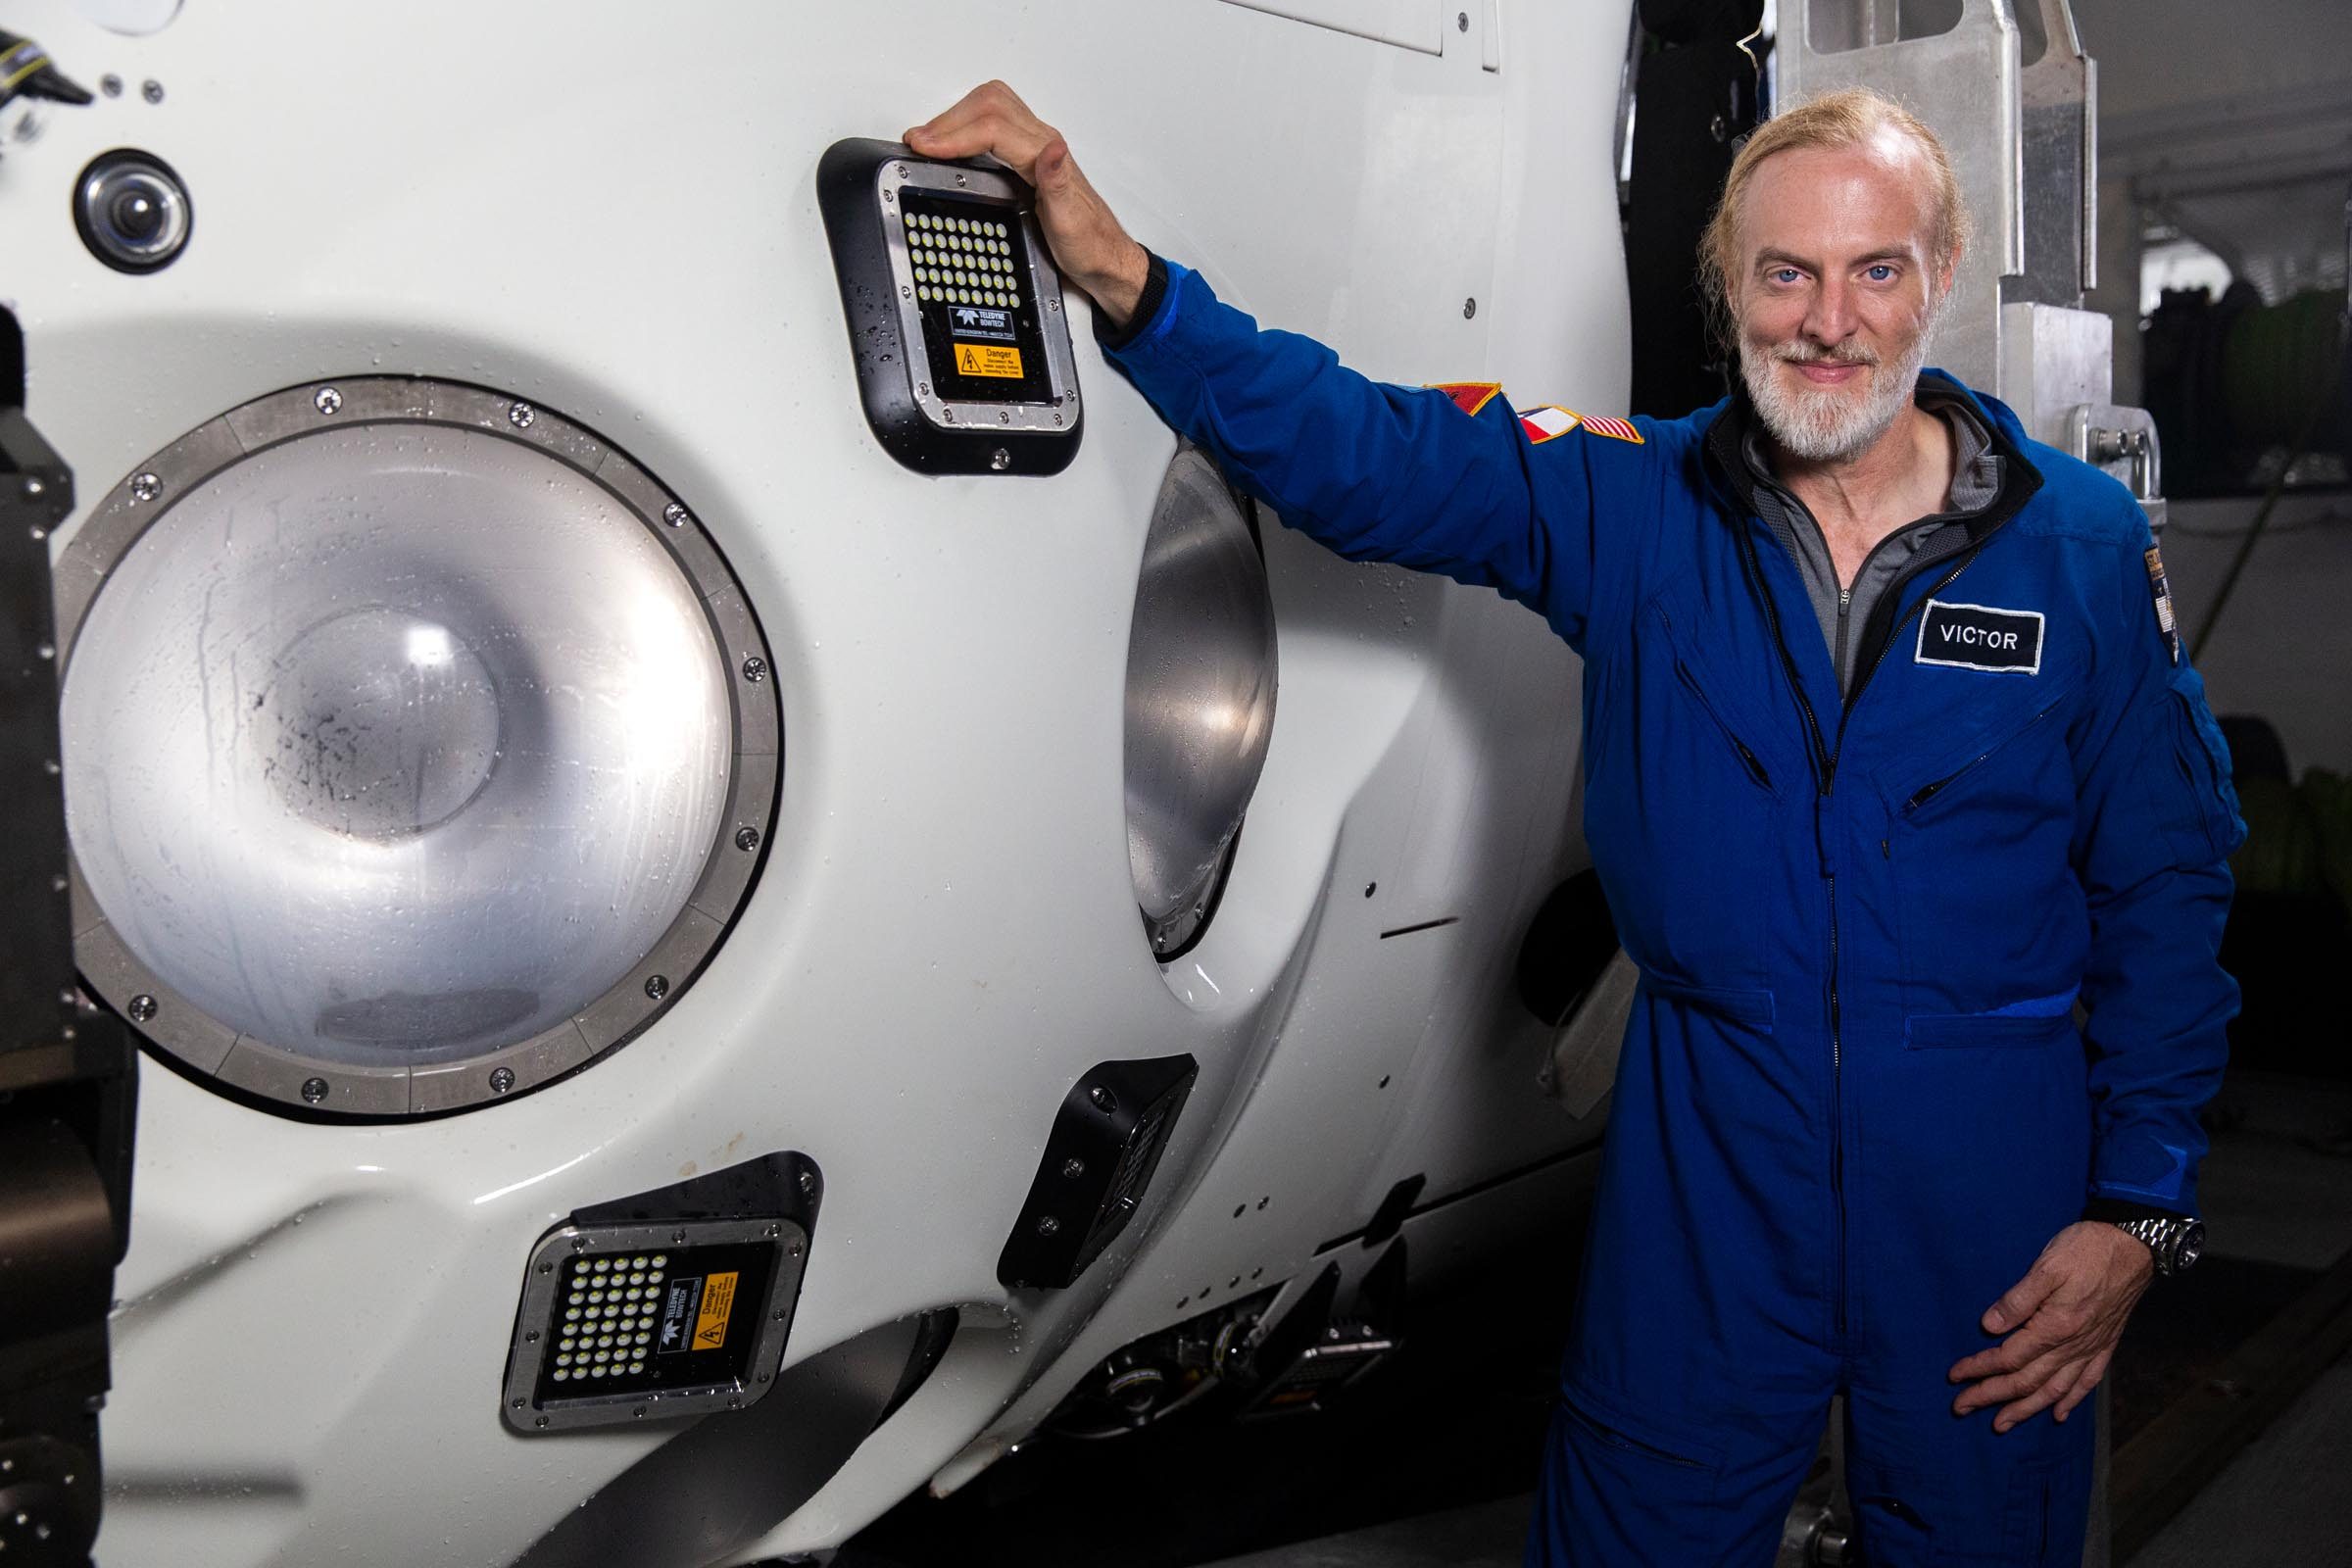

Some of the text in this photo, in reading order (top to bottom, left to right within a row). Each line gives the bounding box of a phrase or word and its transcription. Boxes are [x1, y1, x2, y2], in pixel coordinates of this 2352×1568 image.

[979, 311, 1005, 320] TELEDYNE
[986, 348, 1011, 359] Danger
[1940, 624, 2018, 650] VICTOR
[667, 1287, 680, 1319] TELEDYNE
[675, 1289, 687, 1319] BOWTECH
[703, 1284, 715, 1314] Danger
